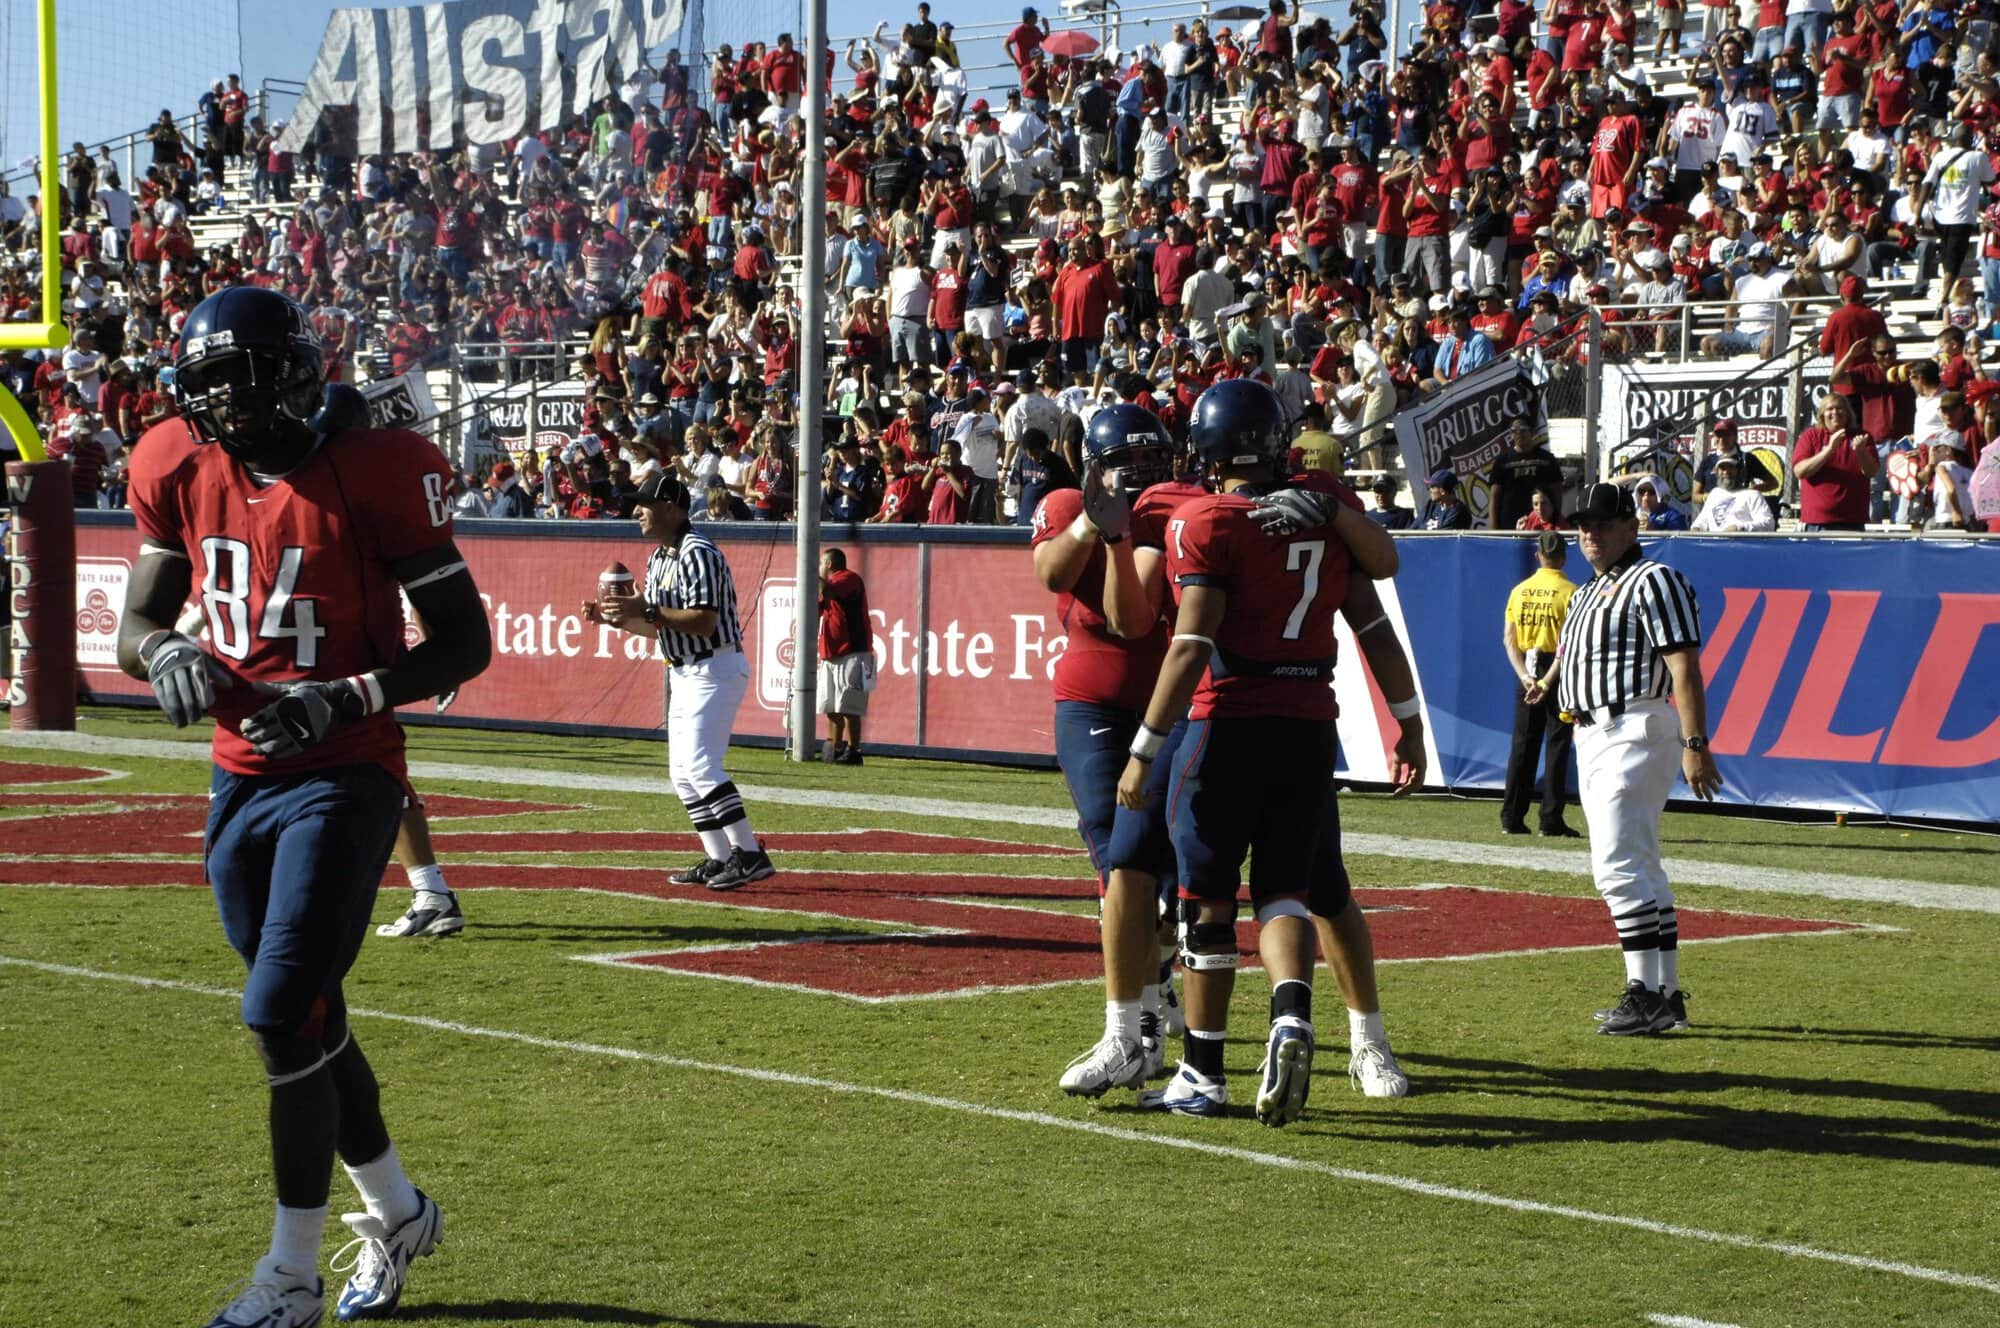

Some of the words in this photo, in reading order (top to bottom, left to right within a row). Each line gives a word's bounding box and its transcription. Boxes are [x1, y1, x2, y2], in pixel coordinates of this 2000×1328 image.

[1459, 443, 1501, 473] BAKED
[1171, 519, 1184, 559] 7
[99, 574, 122, 584] FARM
[1282, 540, 1325, 640] 7
[1521, 589, 1559, 597] EVENT
[201, 537, 325, 667] 84
[1522, 601, 1553, 610] STAFF
[1272, 665, 1319, 678] ARIZONA
